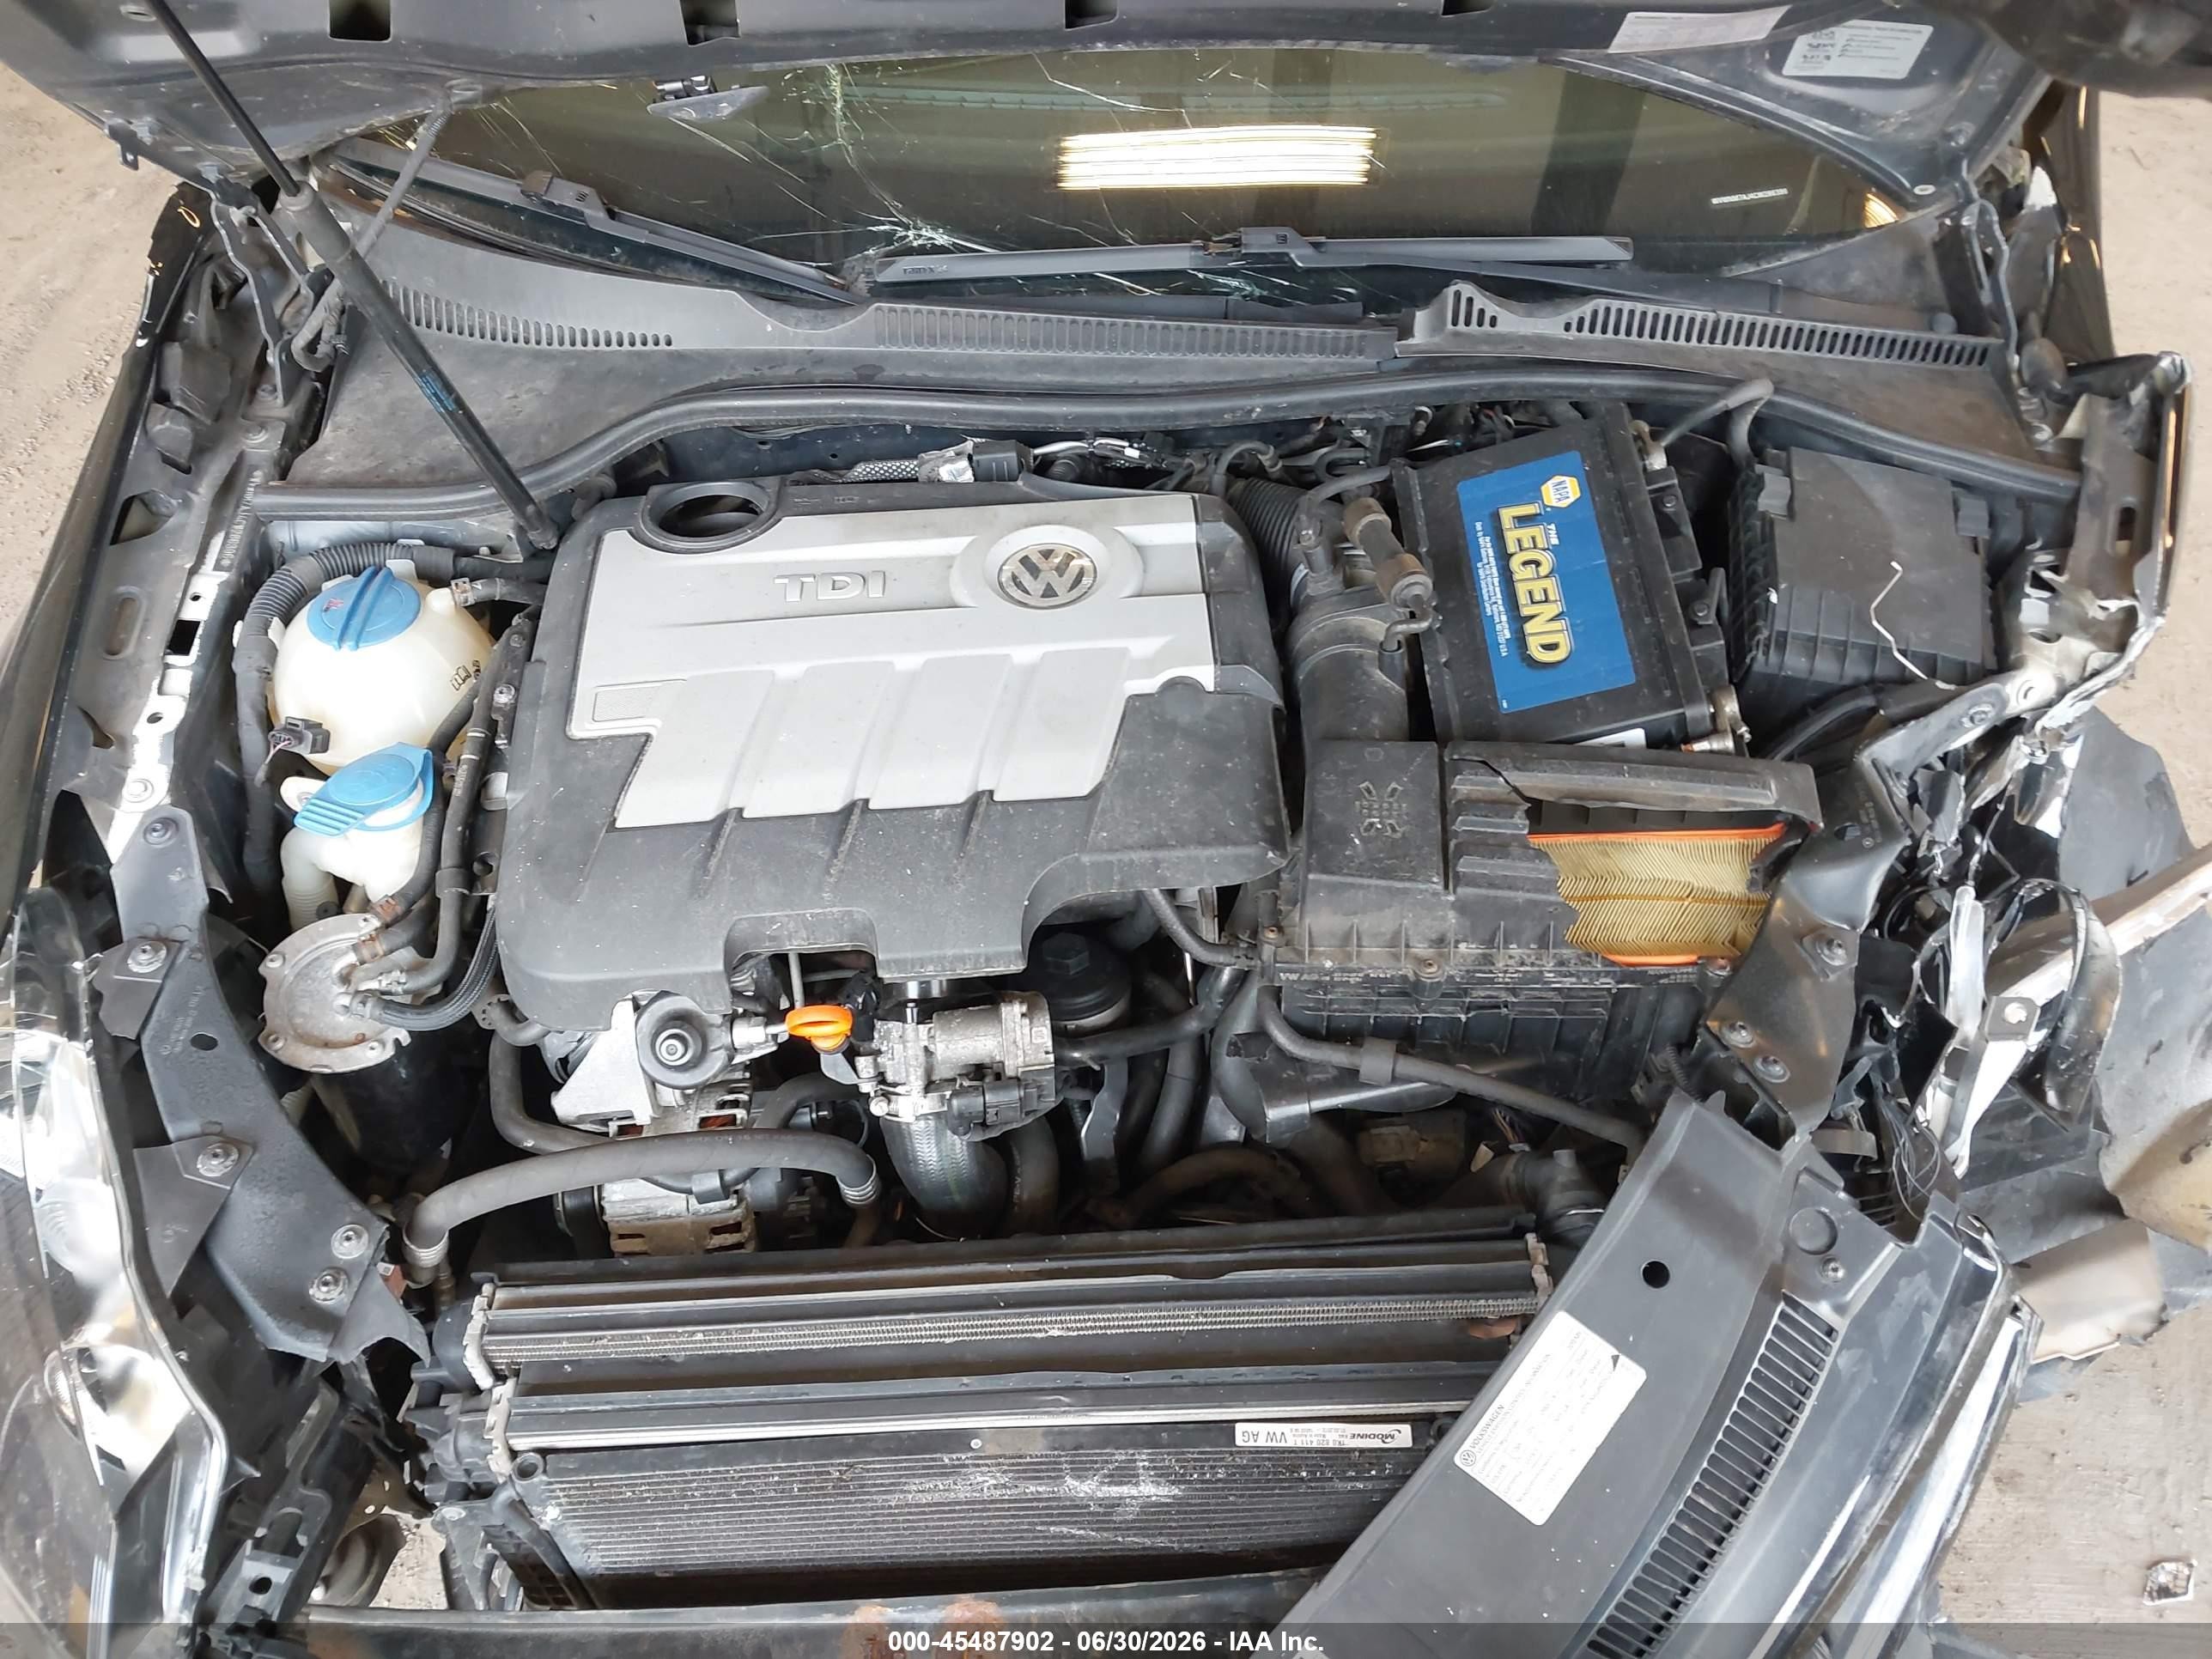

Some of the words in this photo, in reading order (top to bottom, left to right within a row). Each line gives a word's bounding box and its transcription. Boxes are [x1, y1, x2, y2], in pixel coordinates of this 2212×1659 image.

[1551, 477, 1571, 503] NAPA
[1547, 523, 1559, 545] THE
[774, 570, 886, 603] TDI
[1497, 500, 1573, 665] LEGEND
[1242, 1430, 1260, 1443] AG
[1265, 1431, 1288, 1443] VW
[1349, 1431, 1397, 1442] MODINE
[1470, 1404, 1505, 1449] VOLKSWAGEN
